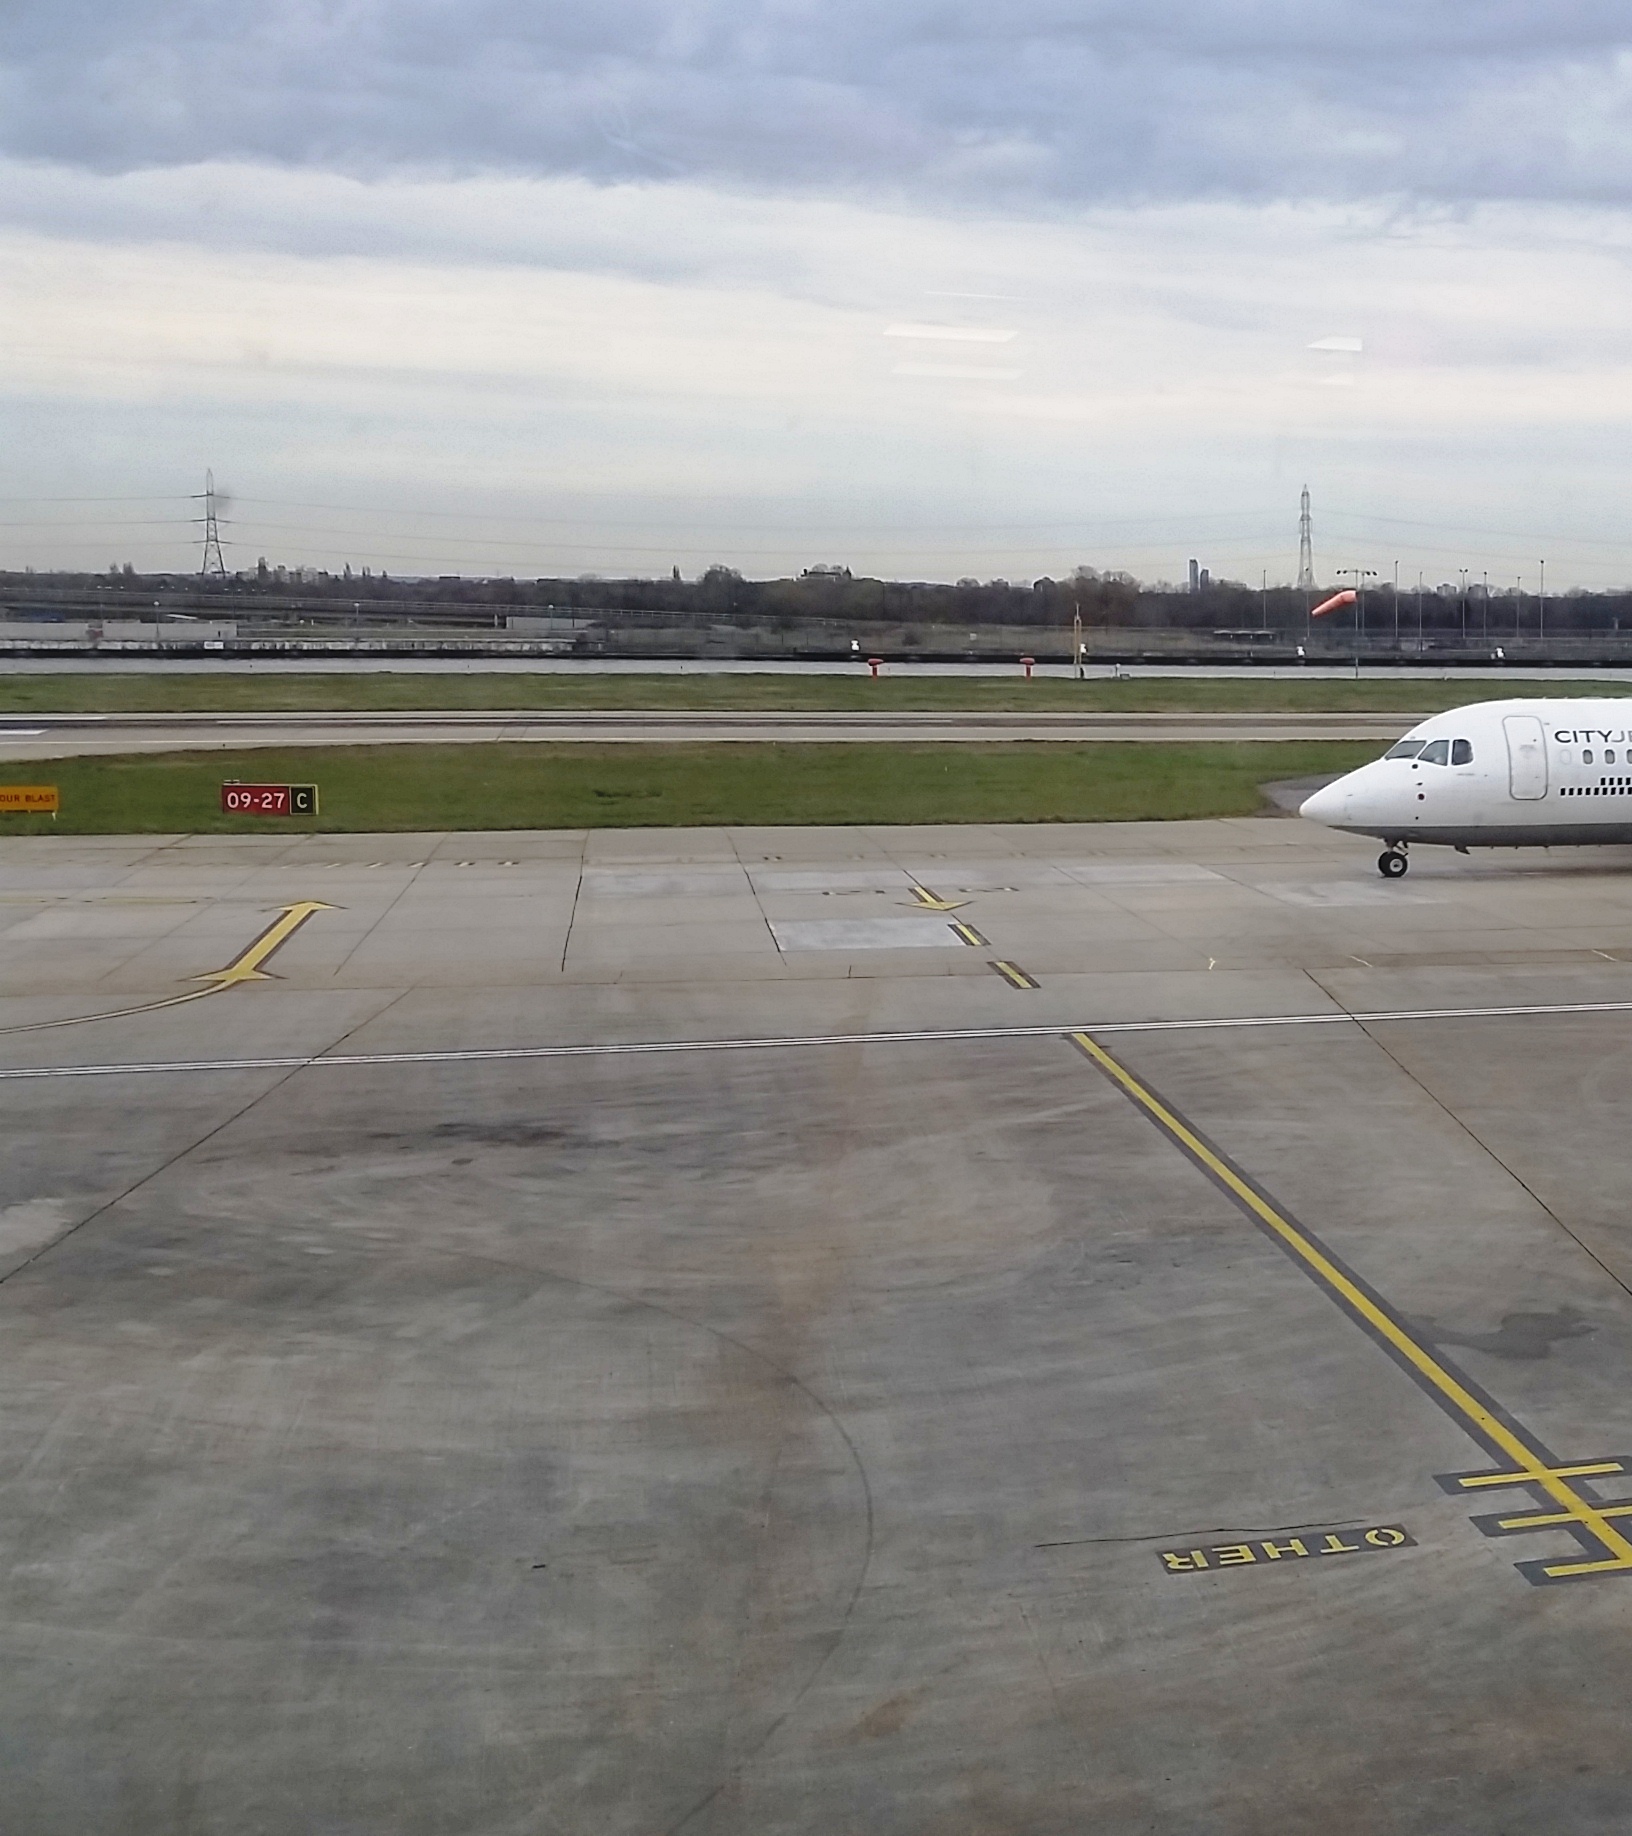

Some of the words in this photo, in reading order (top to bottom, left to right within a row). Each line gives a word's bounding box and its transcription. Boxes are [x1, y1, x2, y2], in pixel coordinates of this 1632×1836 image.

[25, 794, 55, 802] BLAST
[226, 792, 285, 809] 09-27
[296, 792, 308, 809] C
[1163, 1527, 1407, 1571] OTHER
